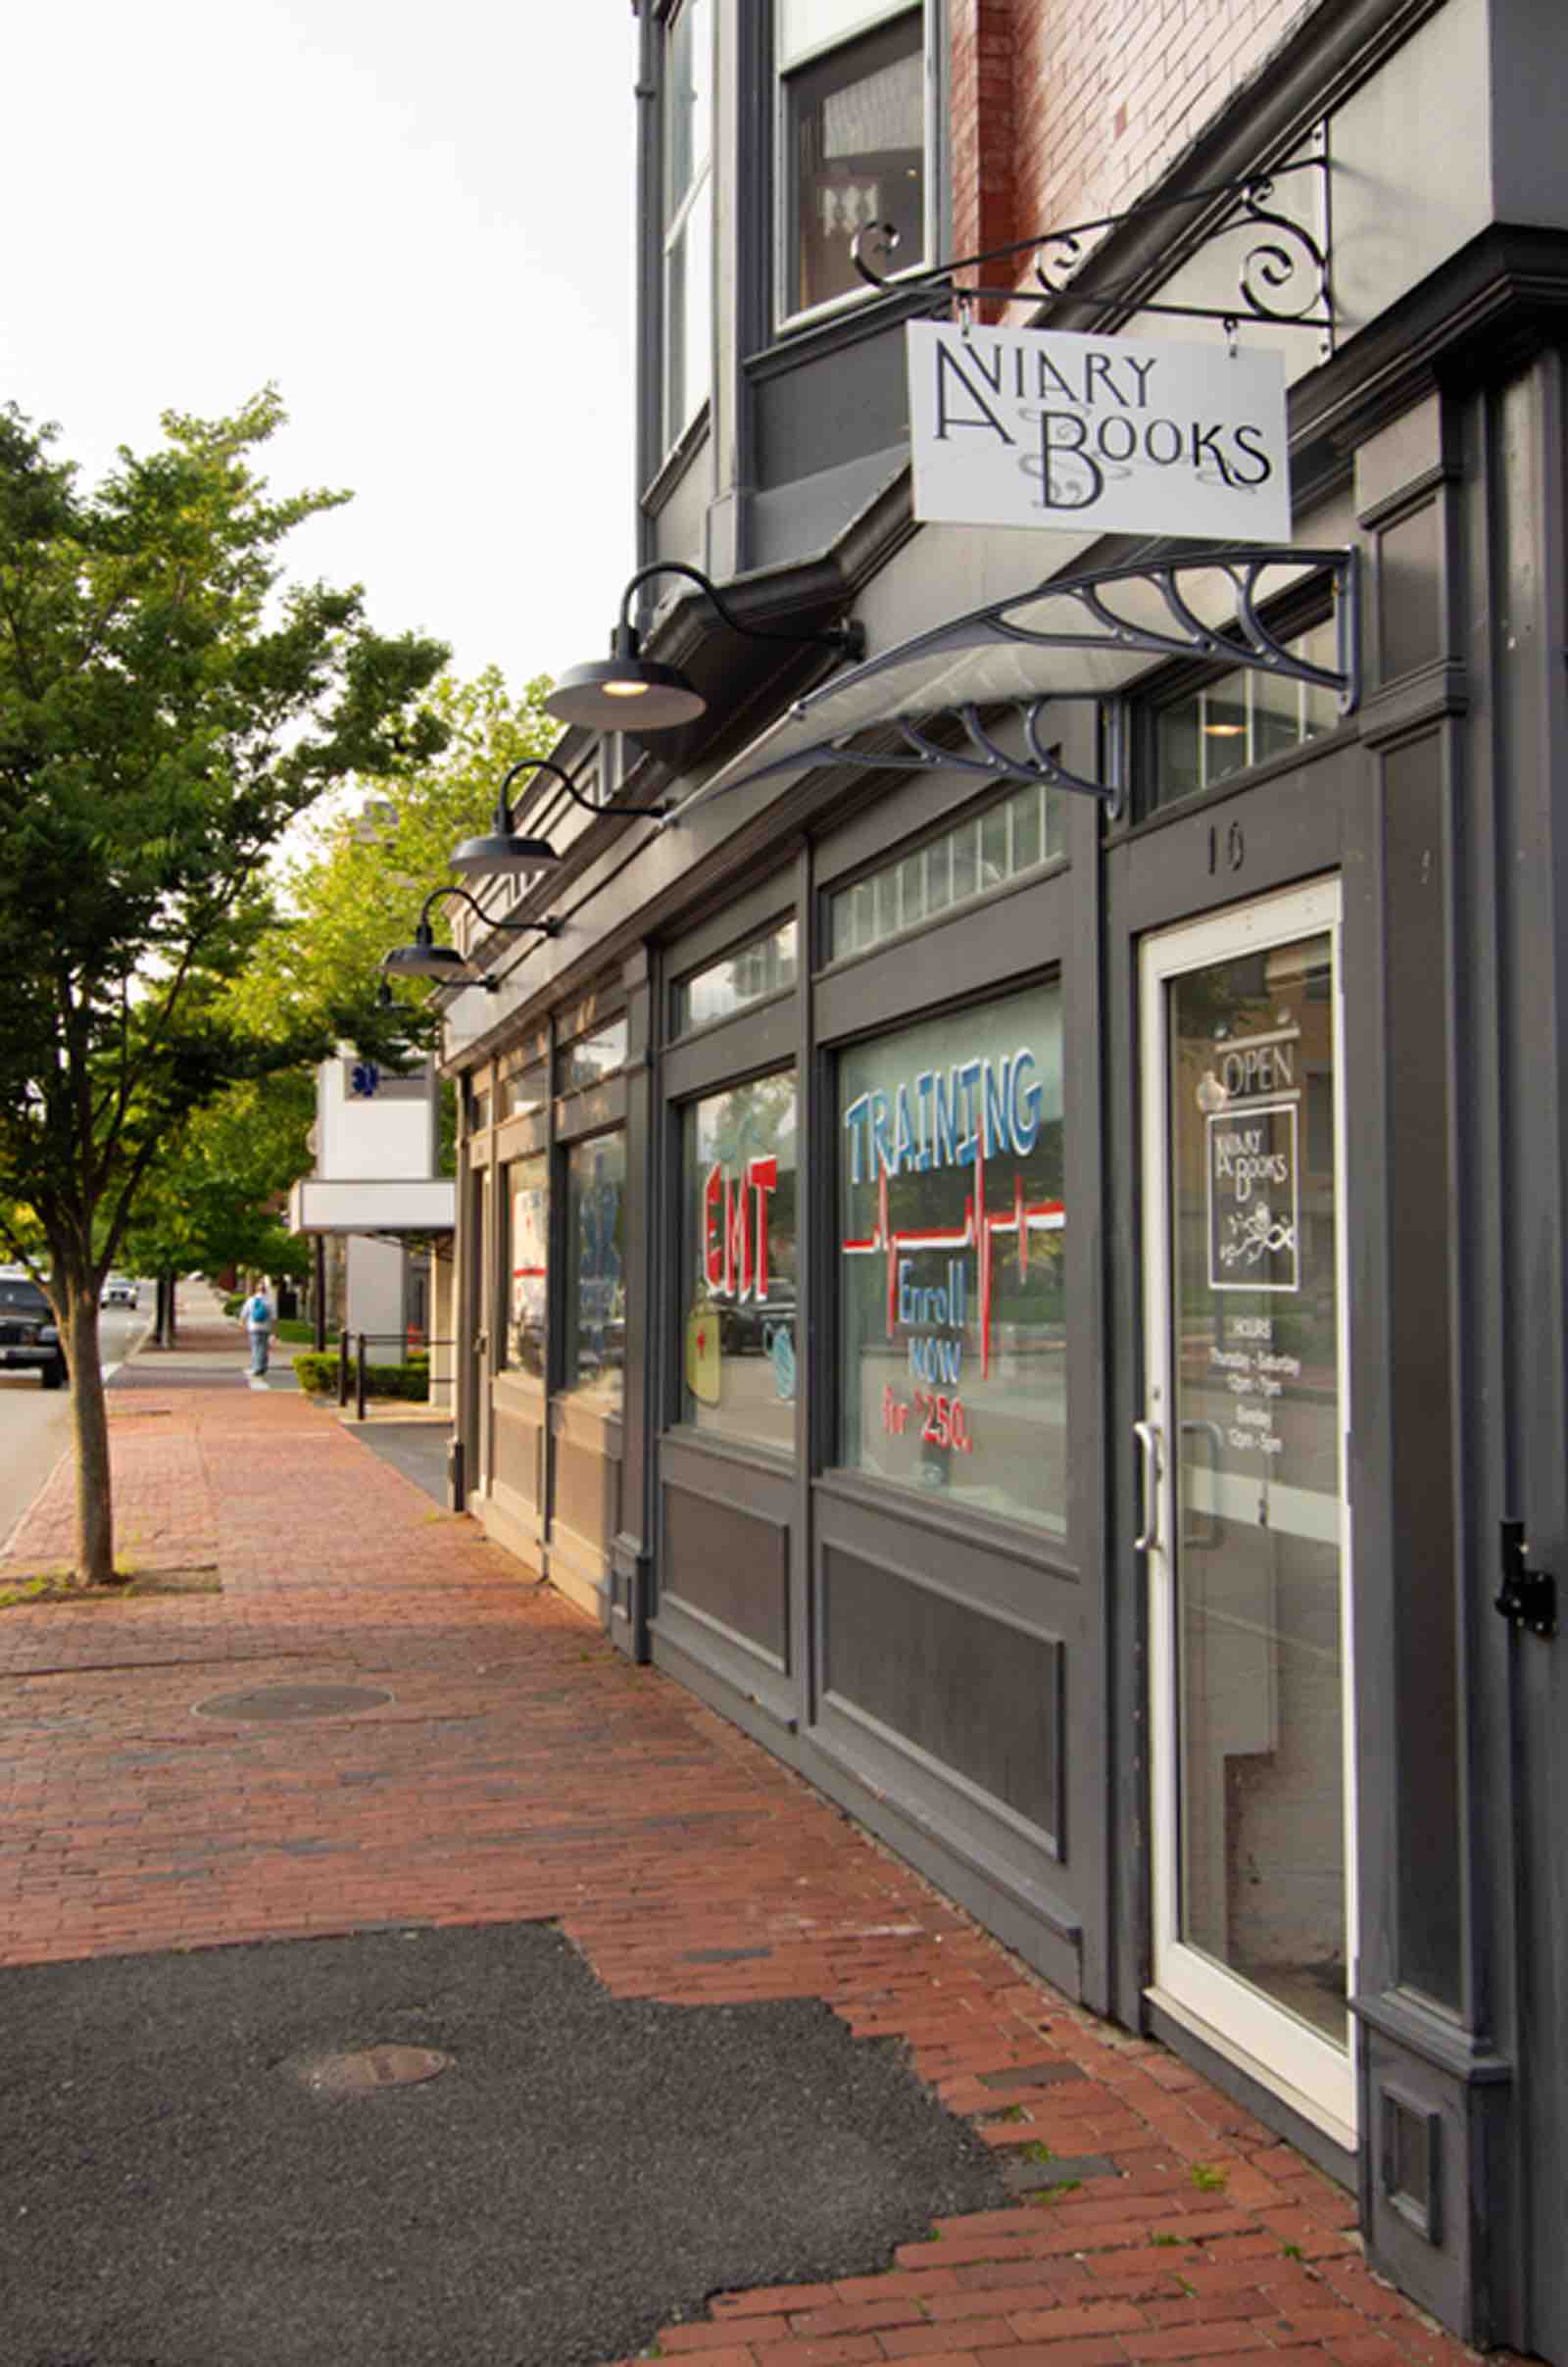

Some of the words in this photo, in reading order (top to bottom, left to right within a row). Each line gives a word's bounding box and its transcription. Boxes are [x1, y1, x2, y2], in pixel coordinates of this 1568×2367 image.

[933, 339, 1157, 445] AVIARY
[1041, 411, 1272, 510] BOOKS
[844, 1048, 1044, 1184] TRAINING
[1222, 1043, 1296, 1096] OPEN
[705, 1155, 777, 1304] EMT
[898, 1258, 966, 1329] Enroll
